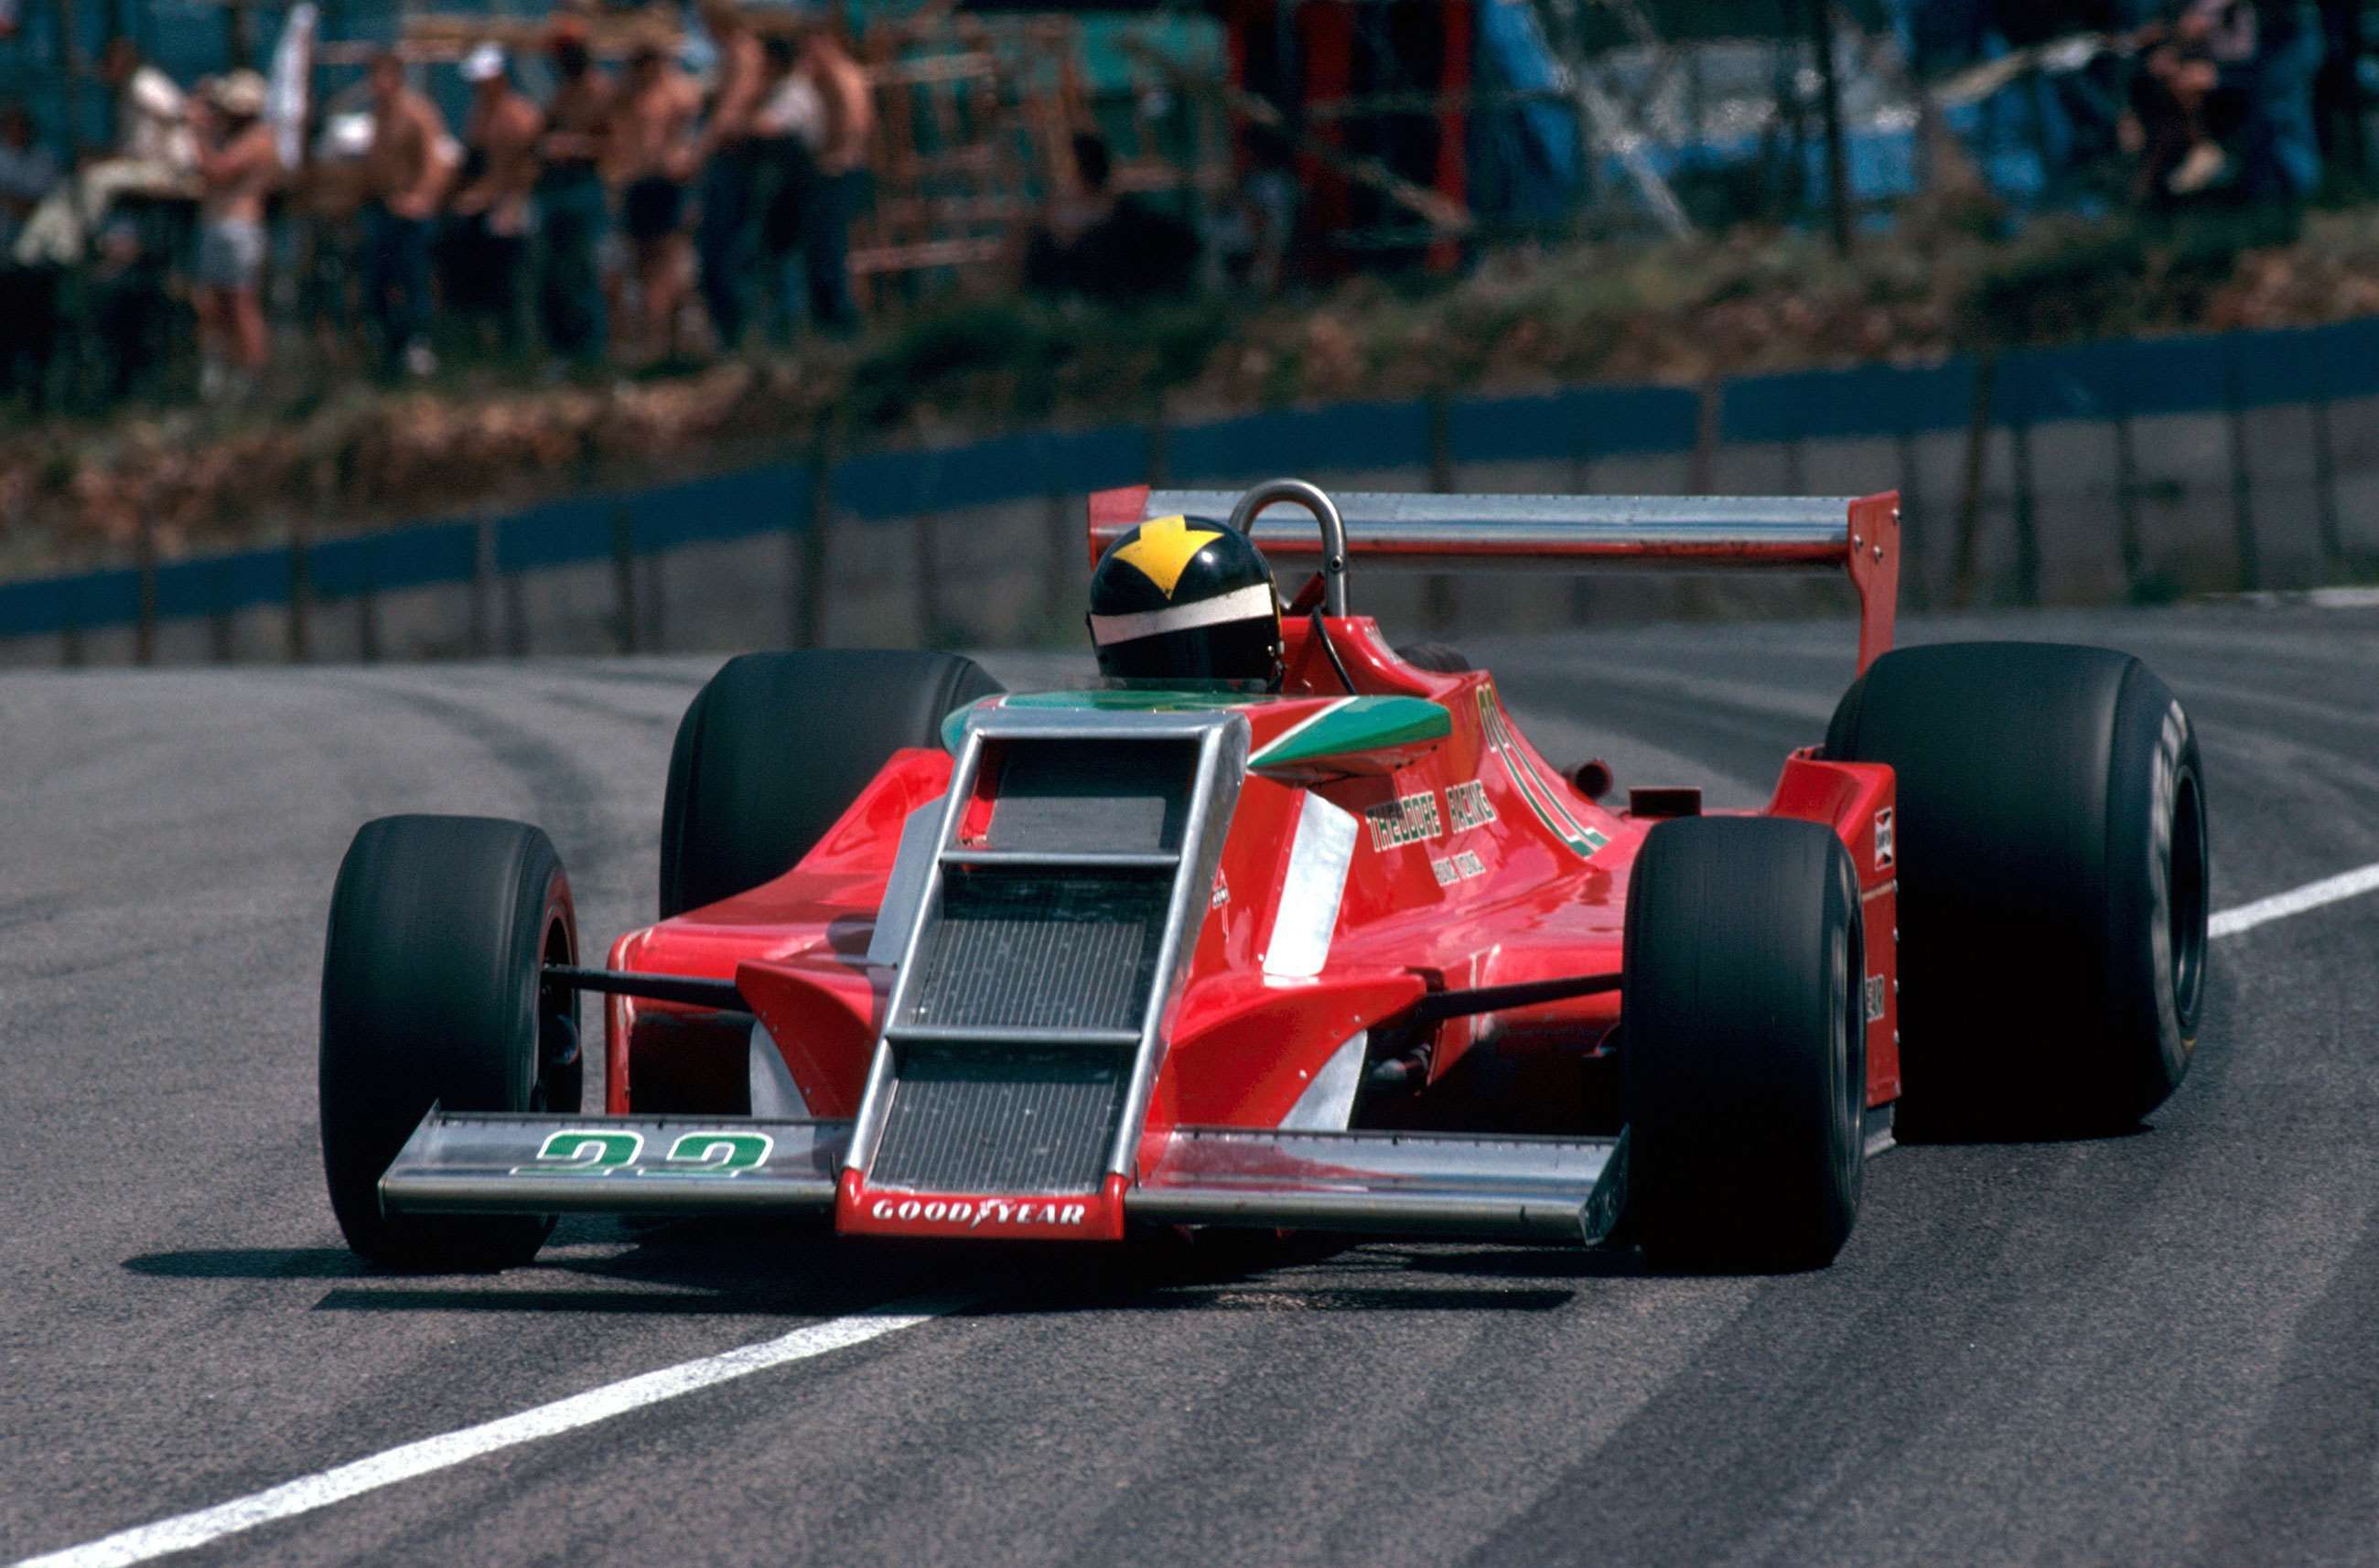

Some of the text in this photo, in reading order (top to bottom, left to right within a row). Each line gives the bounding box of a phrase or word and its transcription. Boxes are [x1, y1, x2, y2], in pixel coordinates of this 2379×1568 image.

[1365, 779, 1497, 853] THEODORE RACING
[872, 1197, 1085, 1229] GOODYEAR
